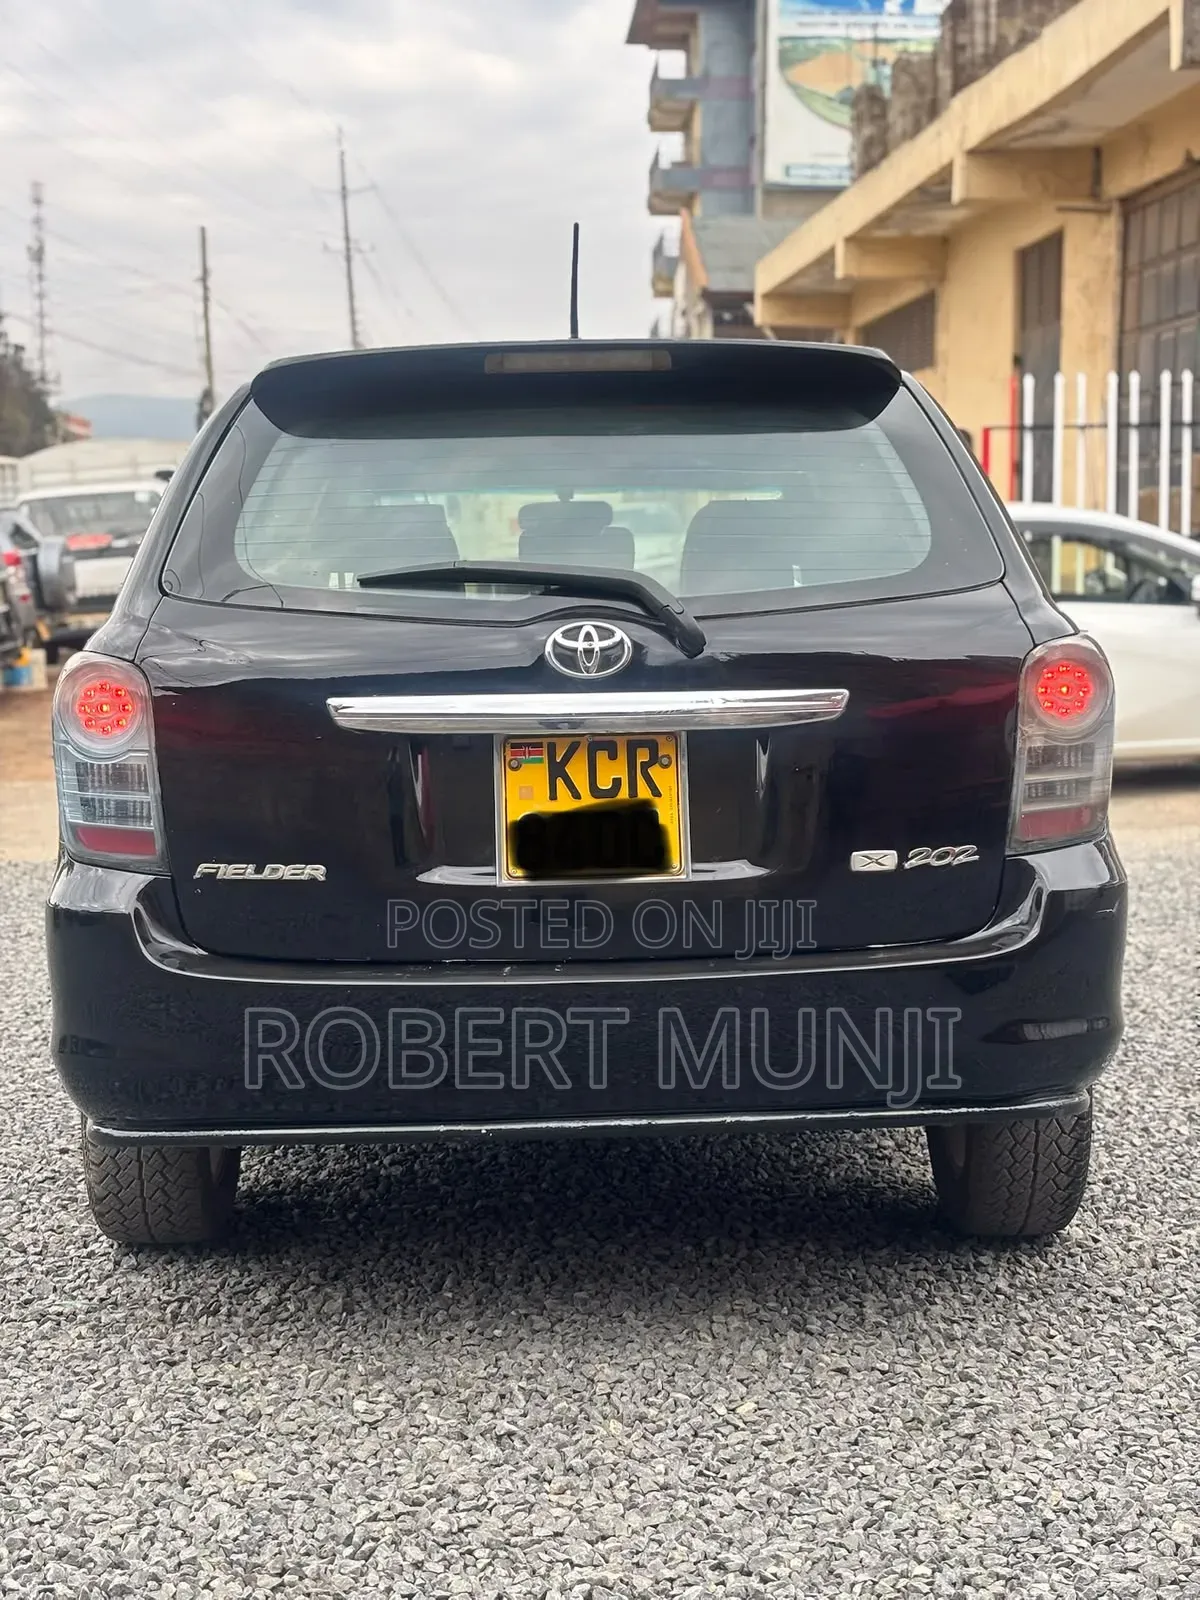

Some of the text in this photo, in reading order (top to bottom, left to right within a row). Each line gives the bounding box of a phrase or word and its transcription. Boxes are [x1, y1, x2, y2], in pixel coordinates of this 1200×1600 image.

[547, 739, 663, 801] KCR
[904, 845, 980, 869] 202
[193, 863, 327, 881] FIELDER
